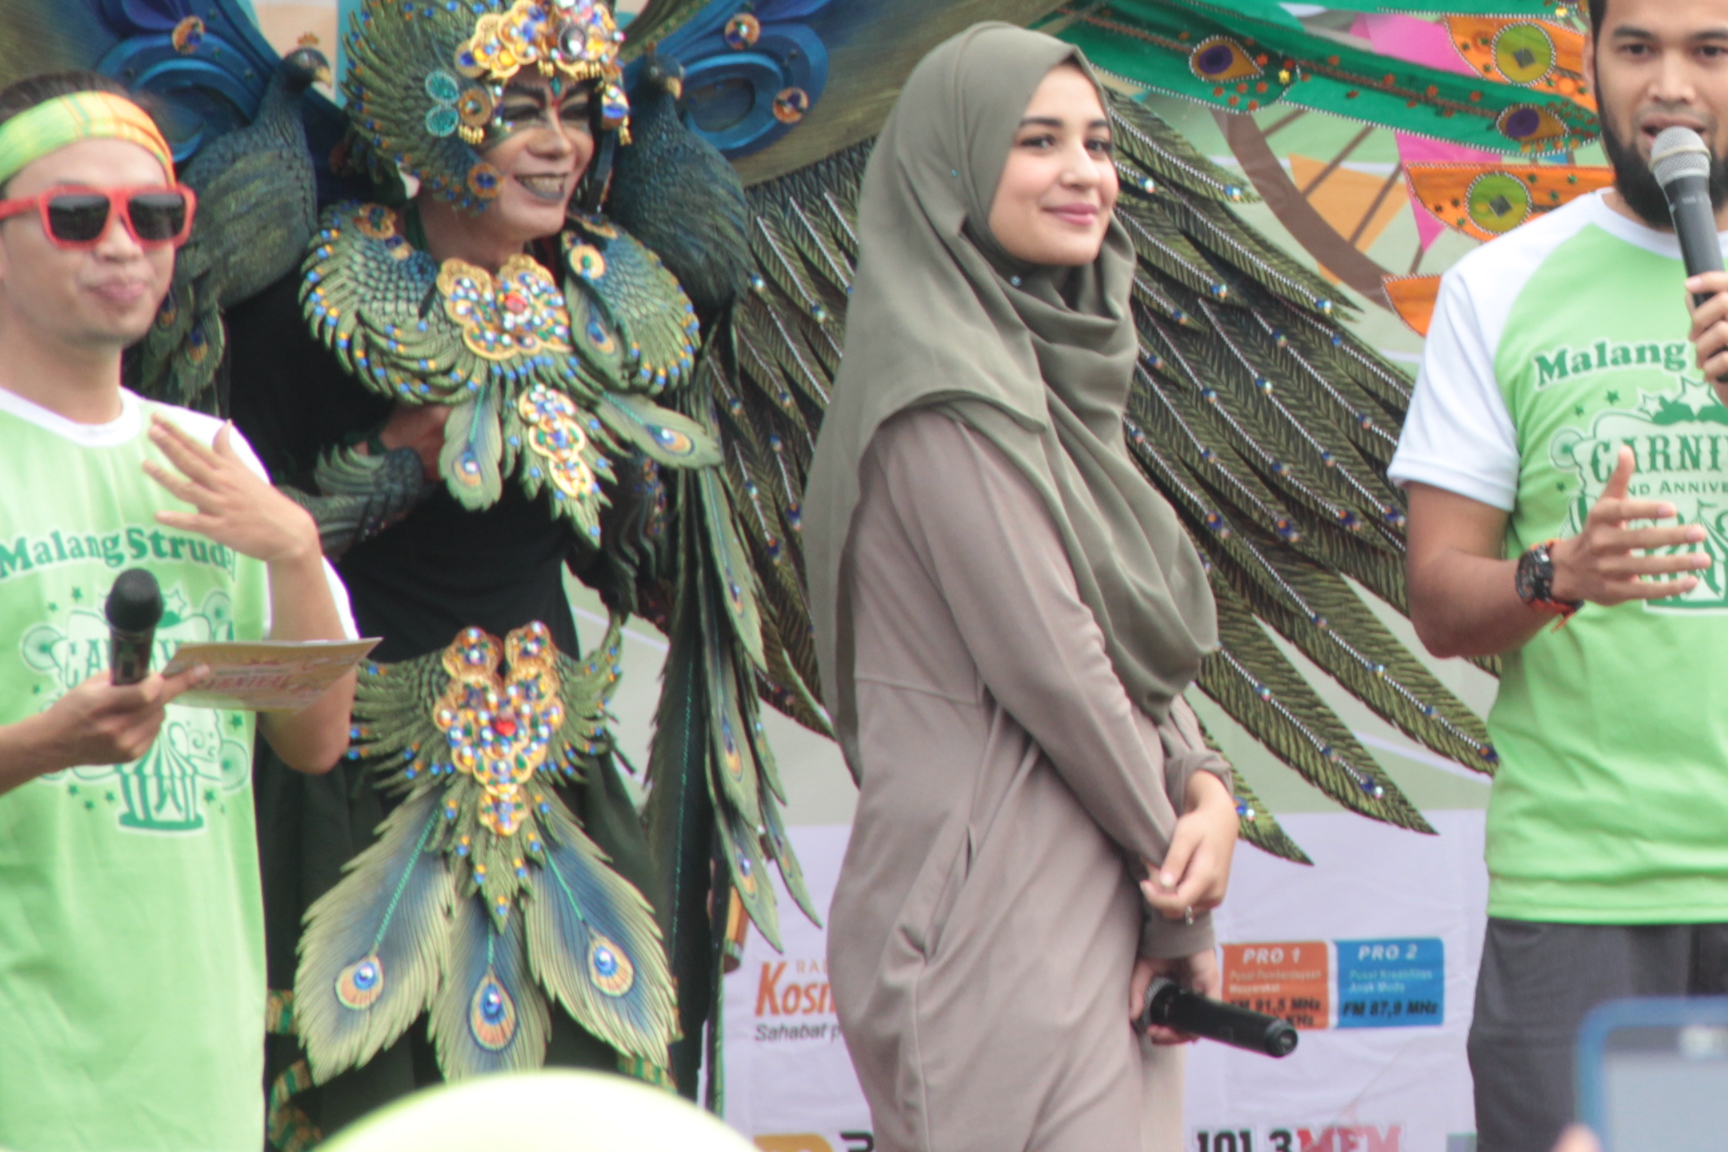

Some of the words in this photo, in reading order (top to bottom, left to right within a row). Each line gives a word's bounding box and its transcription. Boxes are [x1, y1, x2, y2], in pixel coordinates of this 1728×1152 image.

[1535, 341, 1687, 387] Malang
[1626, 482, 1651, 497] ND
[1242, 947, 1284, 965] PRO
[1291, 947, 1302, 964] 1
[1357, 943, 1400, 962] PRO
[1405, 943, 1419, 961] 2
[1343, 1000, 1366, 1017] FM
[1407, 999, 1438, 1016] MHz
[755, 1023, 827, 1042] Sahabat
